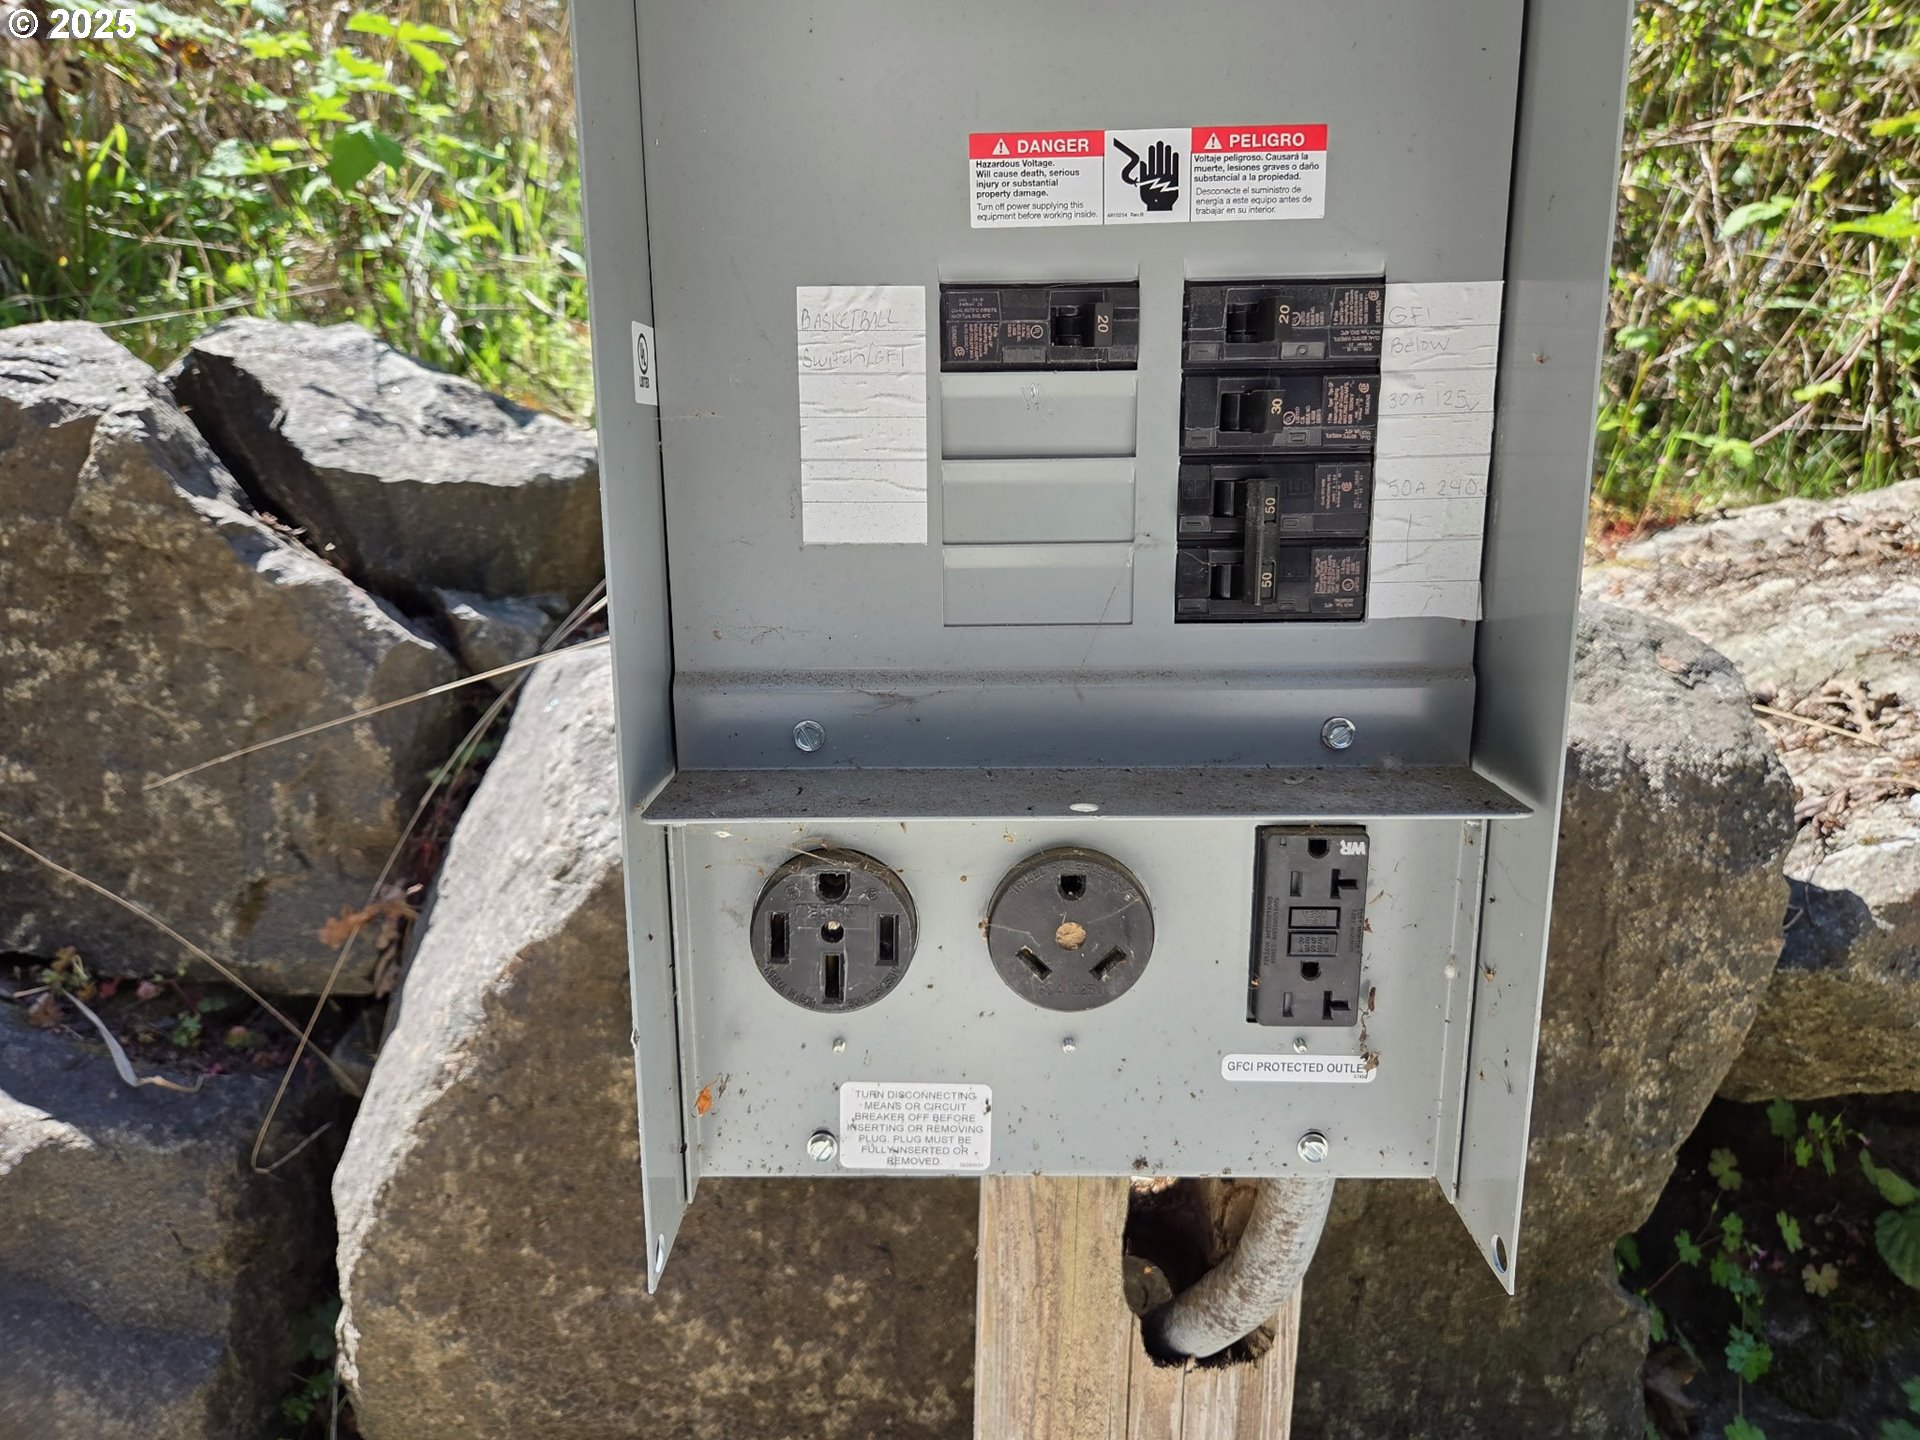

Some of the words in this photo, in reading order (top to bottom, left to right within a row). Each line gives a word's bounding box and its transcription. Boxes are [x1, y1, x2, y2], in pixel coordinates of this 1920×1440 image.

[1229, 132, 1305, 148] PELIGRO
[1017, 138, 1089, 154] DANGER
[1194, 154, 1221, 164] Voltaje
[1223, 153, 1263, 163] peligroso.
[1265, 152, 1299, 161] Causará
[1301, 152, 1309, 160] la
[975, 160, 1020, 169] Hazardous
[1021, 159, 1055, 169] Voltage.
[1194, 164, 1225, 173] muerte,
[1226, 163, 1260, 172] lesiones
[1262, 164, 1290, 172] graves
[1299, 162, 1319, 171] daño
[976, 170, 991, 178] Will
[1020, 169, 1047, 178] death,
[1049, 168, 1080, 177] serious
[1193, 173, 1240, 183] substancial
[1249, 173, 1256, 181] la
[1258, 173, 1302, 182] propiedad.
[976, 181, 999, 189] injury
[1012, 179, 1059, 187] substantial
[976, 190, 1011, 199] property
[1013, 188, 1049, 199] damage.
[1196, 187, 1241, 196] Desconecte
[1242, 186, 1250, 195] el
[1251, 186, 1290, 195] suministro
[1291, 185, 1302, 193] de
[977, 202, 993, 211] Turn
[995, 201, 1005, 210] off
[1006, 202, 1030, 211] power
[1032, 201, 1069, 211] supplying
[1070, 201, 1084, 209] this
[1196, 196, 1224, 206] energía
[1250, 196, 1277, 205] equipo
[1301, 195, 1312, 203] de
[977, 212, 1016, 222] equipment
[1017, 211, 1041, 220] before
[1043, 211, 1072, 220] working
[1073, 210, 1098, 218] inside.
[1195, 207, 1224, 216] trabajar
[1248, 206, 1276, 214] interior.
[801, 308, 899, 331] BASKETBALL
[1279, 305, 1290, 324] 20
[1388, 306, 1431, 325] GFI
[1097, 315, 1109, 333] 20
[1391, 336, 1450, 354] Below
[1271, 398, 1282, 415] 30
[1265, 497, 1276, 514] 50
[1261, 572, 1272, 589] 50
[1339, 839, 1367, 856] WR
[1227, 1061, 1253, 1072] GFCI
[1256, 1062, 1324, 1073] PROTECTED
[1327, 1062, 1365, 1074] OUTLE
[855, 1090, 884, 1099] TURN
[887, 1090, 977, 1100] DISCONNECTING
[864, 1101, 902, 1110] MEANS
[905, 1102, 921, 1111] OR
[923, 1102, 967, 1111] CIRCUIT
[854, 1112, 905, 1122] BREAKER
[907, 1113, 929, 1122] OFF
[932, 1113, 976, 1123] BEFORE
[846, 1123, 904, 1132] INSERTING
[907, 1123, 923, 1132] OR
[926, 1124, 984, 1134] REMOVING
[893, 1134, 922, 1144] PLUG
[924, 1135, 954, 1144] MUST
[957, 1136, 972, 1145] BE
[861, 1145, 894, 1154] FULLY
[897, 1145, 950, 1155] INSERTED
[952, 1146, 969, 1155] OR
